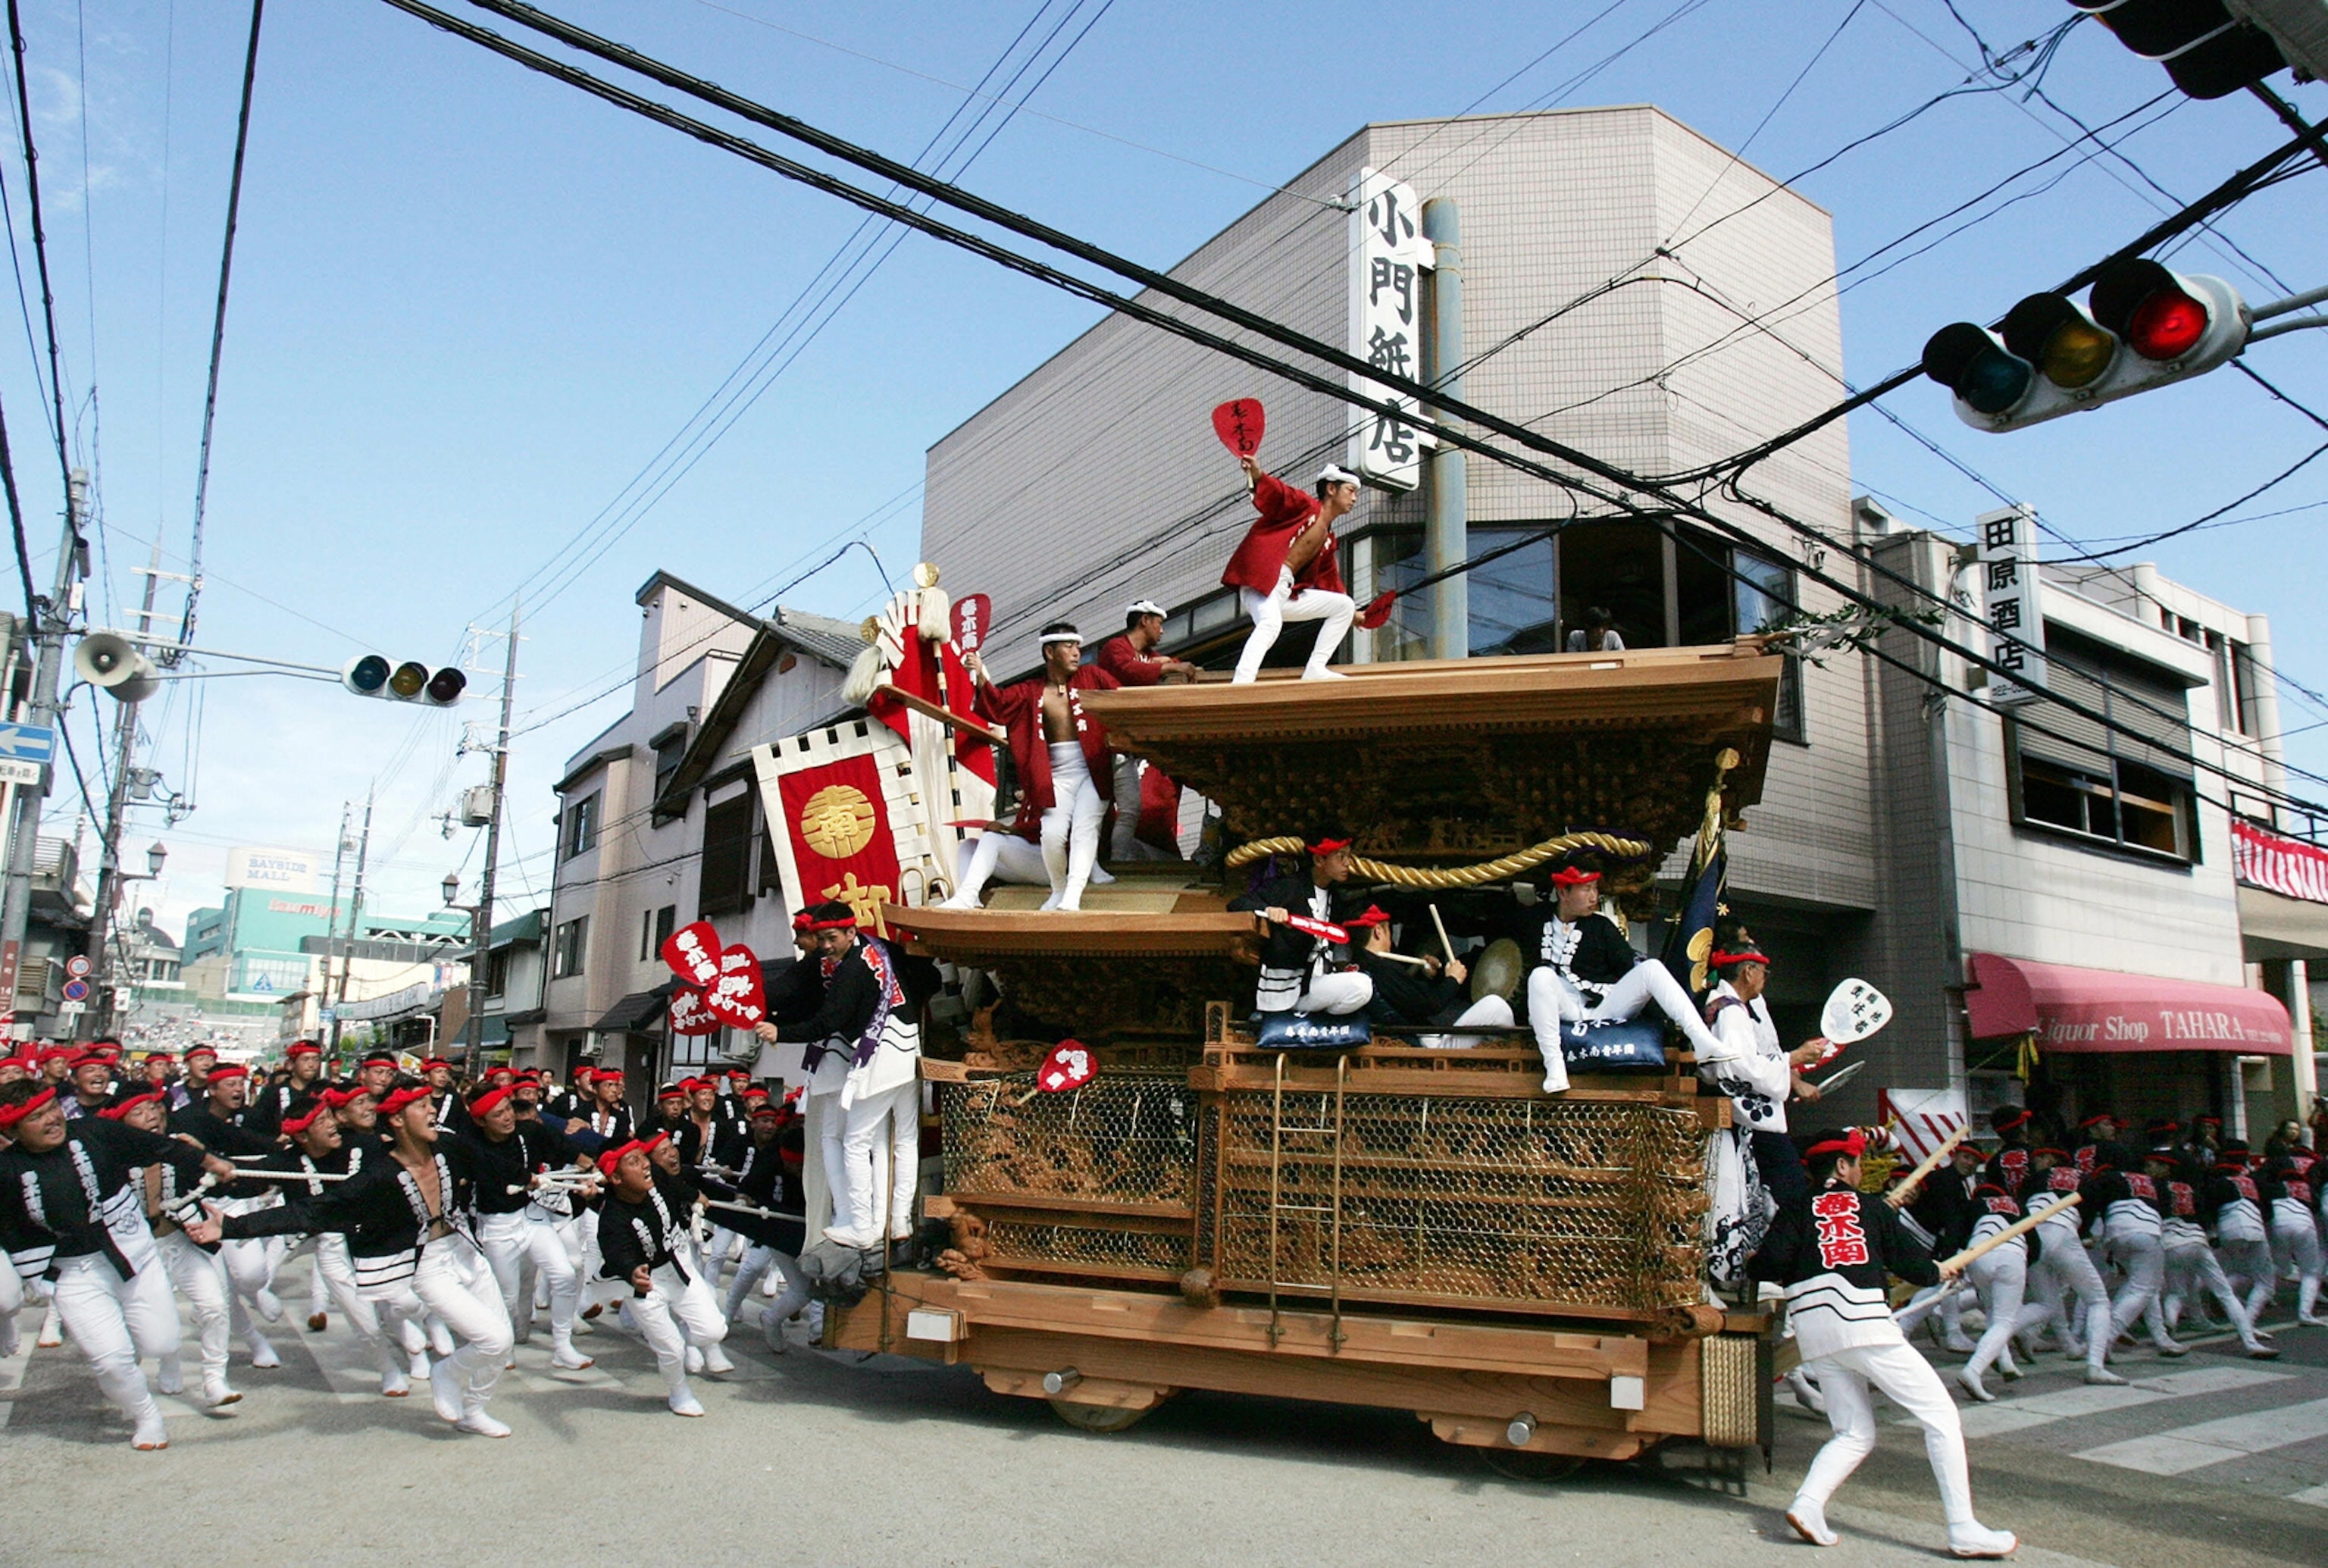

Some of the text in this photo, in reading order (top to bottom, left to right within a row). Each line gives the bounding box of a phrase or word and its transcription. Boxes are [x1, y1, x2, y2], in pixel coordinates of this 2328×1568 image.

[1367, 189, 1415, 465] 小門紙店
[1985, 517, 2024, 671] 田原酒店
[960, 598, 978, 651] 春木南
[247, 869, 290, 881] MALL
[249, 857, 307, 873] BAYSIDE
[676, 929, 718, 983] 春木南
[2104, 1016, 2148, 1043] Shop
[2161, 1010, 2245, 1041] TAHARA
[1812, 1191, 1870, 1269] 春木南
